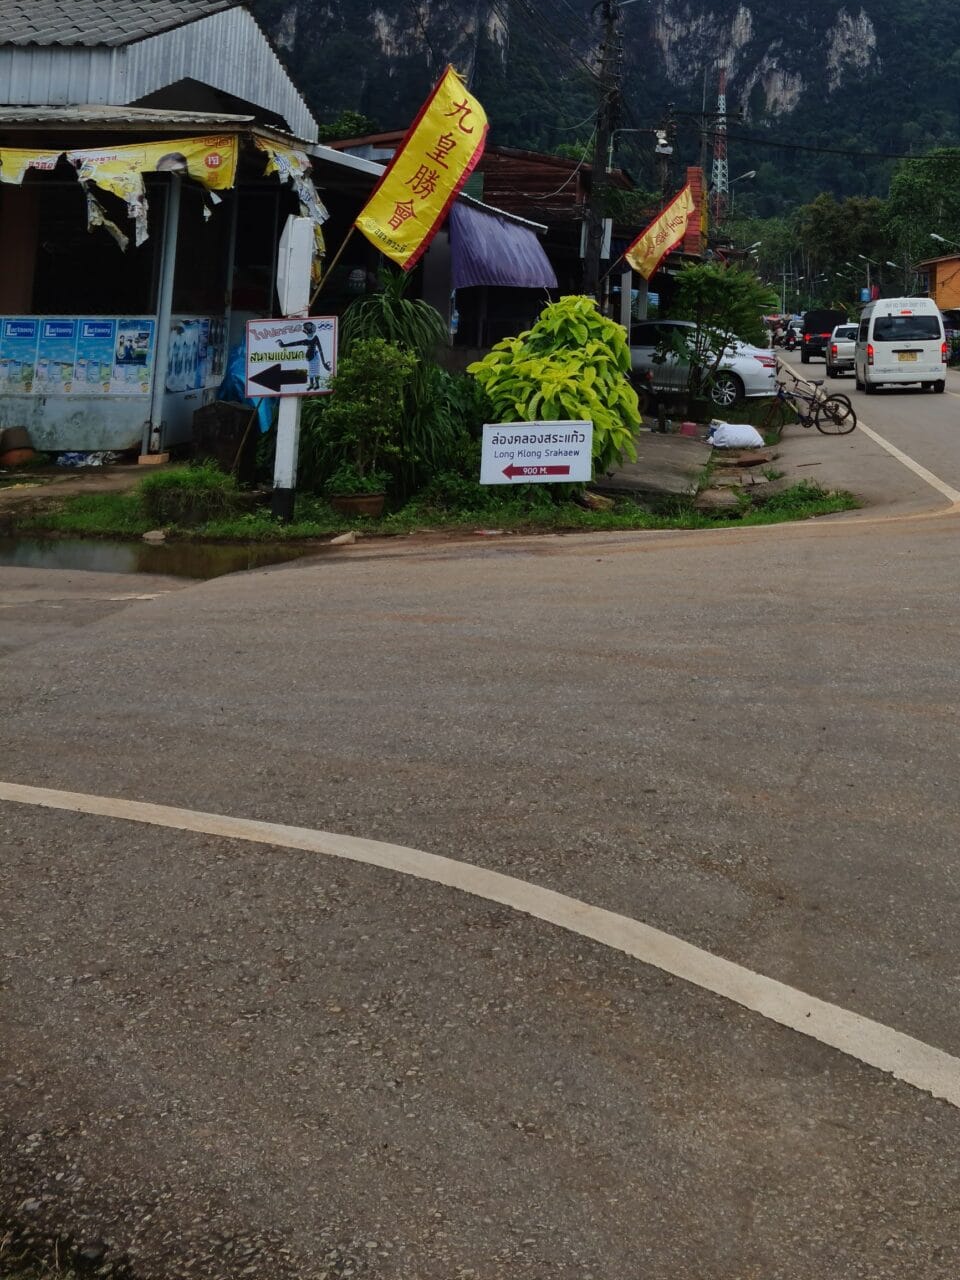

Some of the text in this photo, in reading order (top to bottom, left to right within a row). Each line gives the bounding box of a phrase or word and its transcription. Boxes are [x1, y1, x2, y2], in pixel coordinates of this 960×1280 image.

[387, 98, 474, 231] 九皇勝會
[491, 430, 586, 445] ล่องคลองสระแก้ว
[494, 448, 580, 460] Long Klong Srakaew
[522, 467, 538, 475] 900
